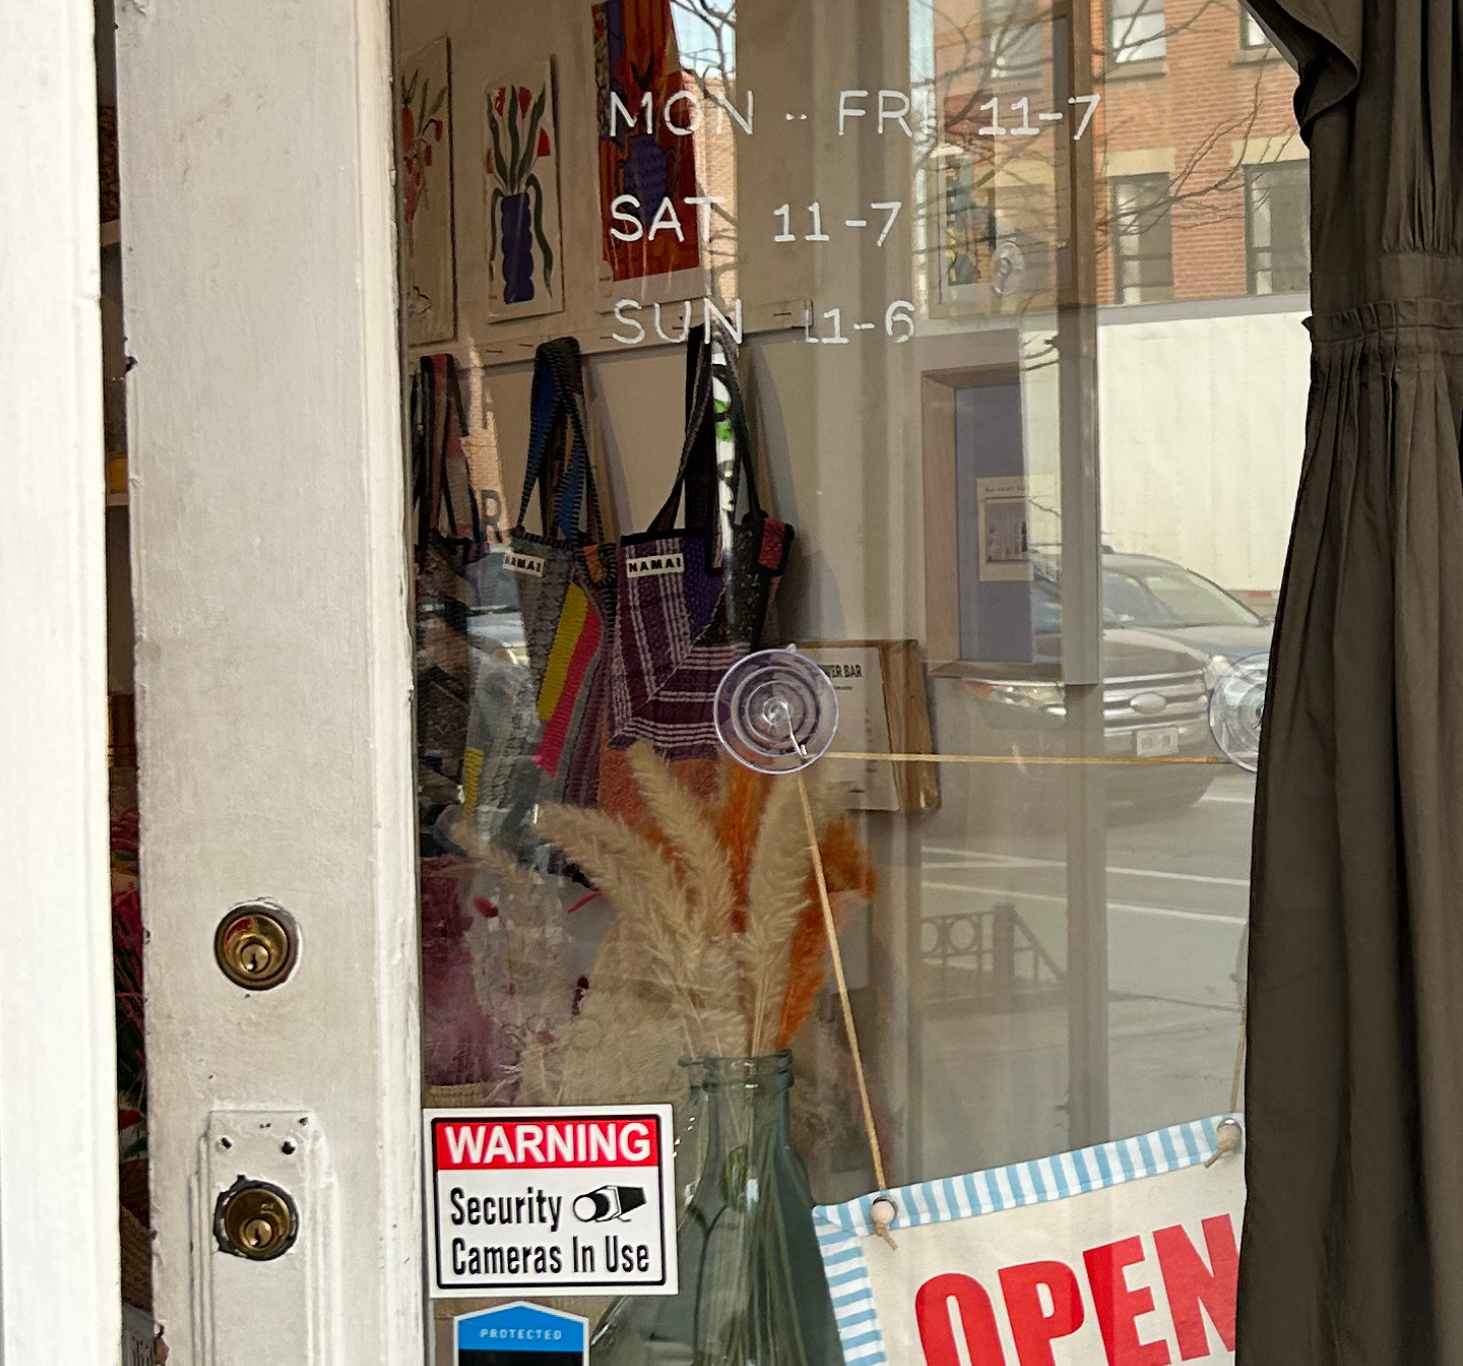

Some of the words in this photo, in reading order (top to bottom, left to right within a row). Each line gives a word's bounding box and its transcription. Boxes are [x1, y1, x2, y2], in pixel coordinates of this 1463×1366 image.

[609, 90, 754, 137] MON
[978, 94, 1101, 141] 11-7
[608, 195, 727, 243] SAT
[773, 201, 903, 248] 11-7
[611, 298, 744, 345] SUN
[804, 299, 916, 345] 11-6
[445, 1122, 651, 1165] WARNING
[450, 1186, 563, 1232] Security
[452, 1237, 562, 1275] Cameras
[573, 1235, 596, 1273] In
[605, 1235, 650, 1273] Use
[480, 1328, 562, 1340] PROTECTED
